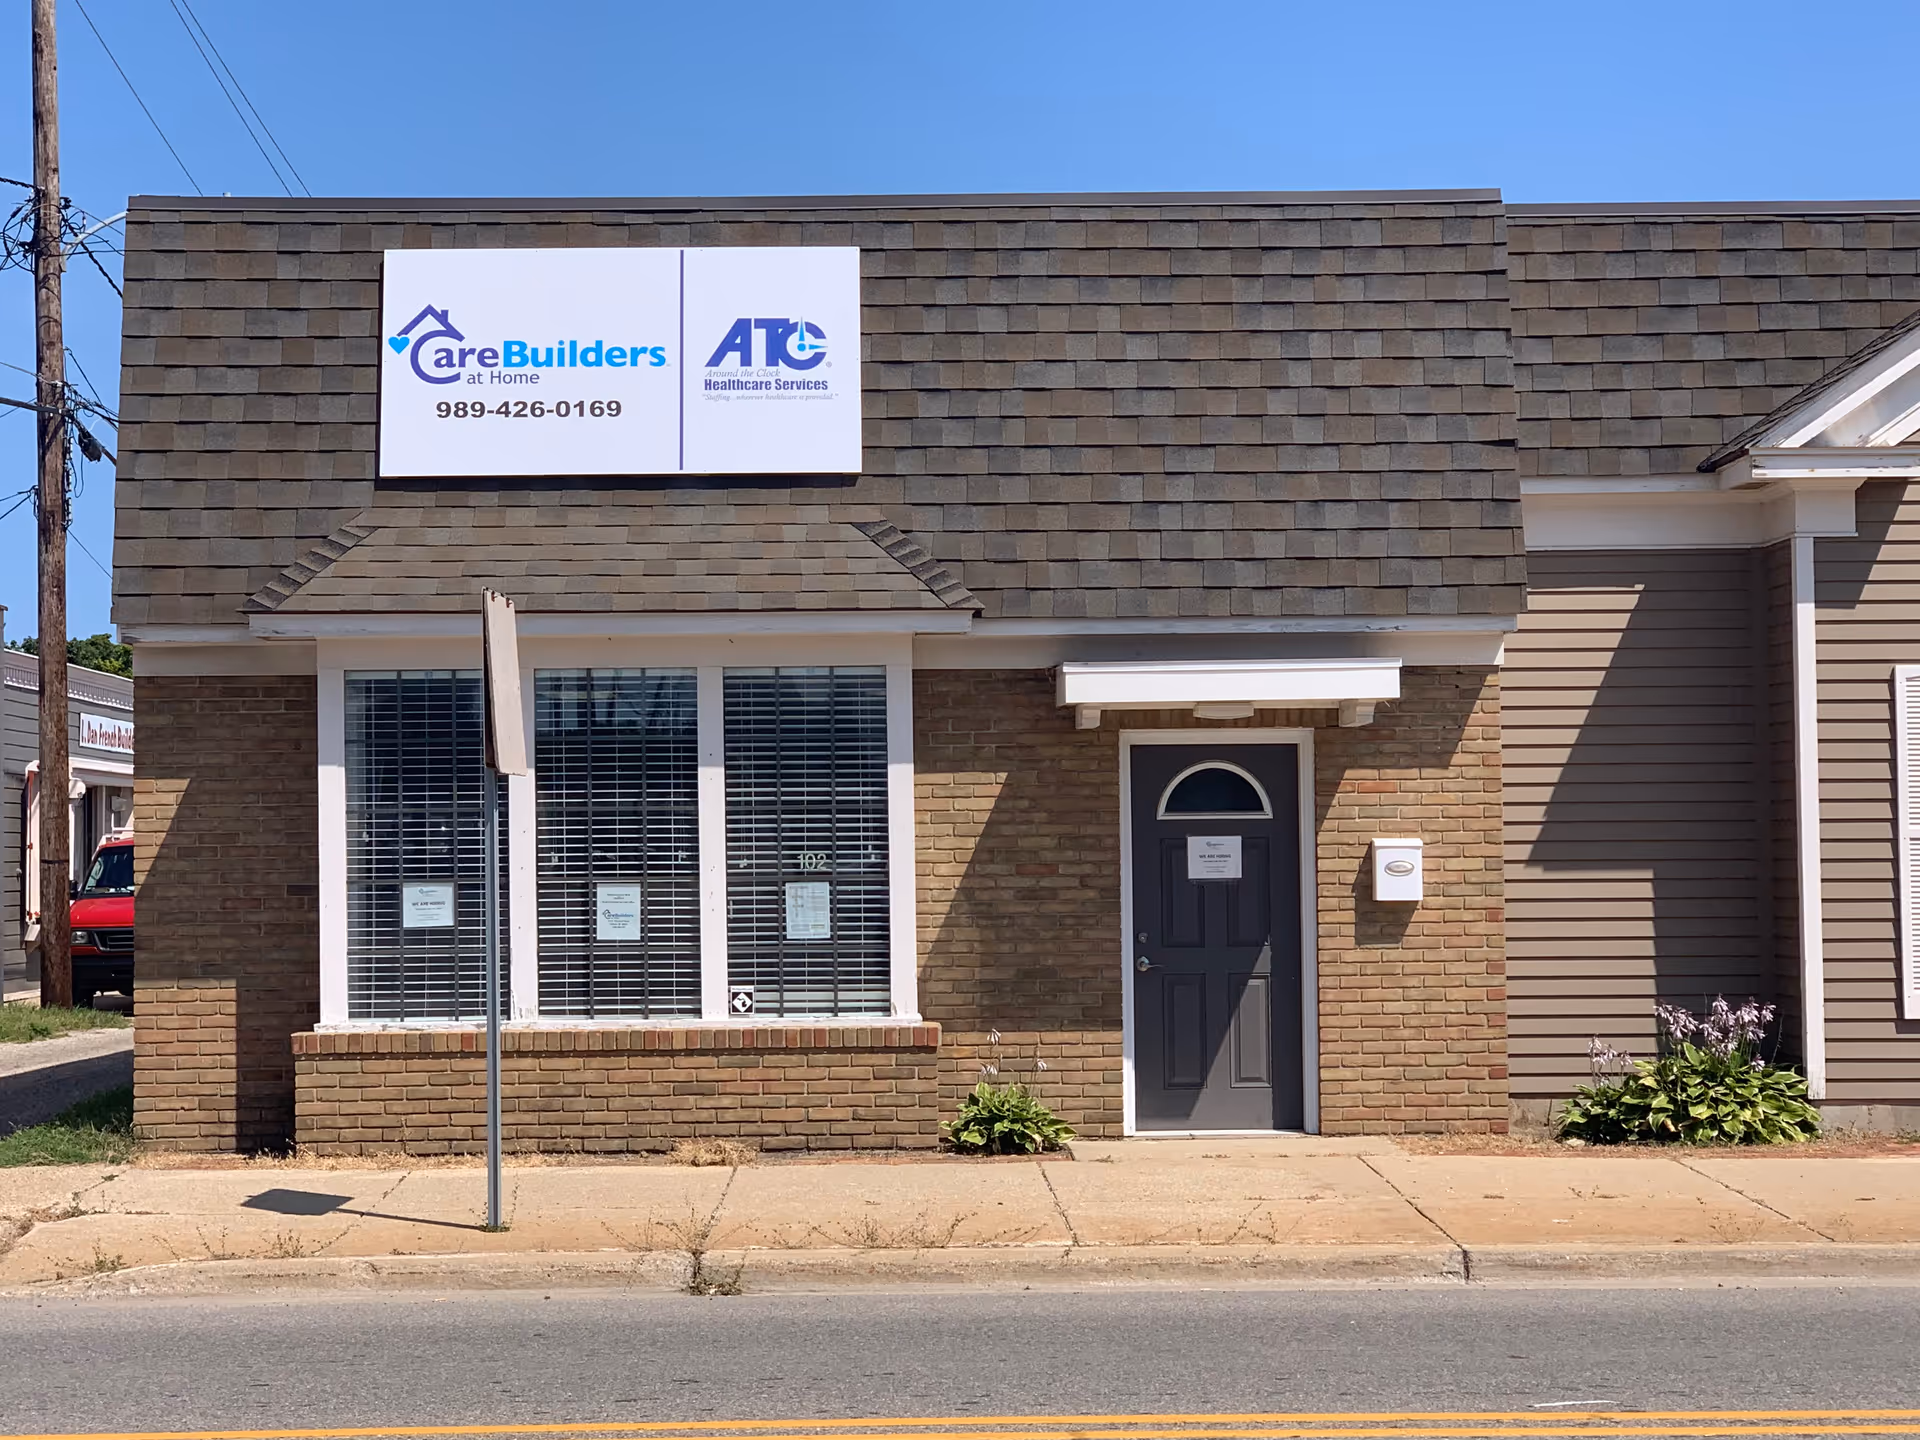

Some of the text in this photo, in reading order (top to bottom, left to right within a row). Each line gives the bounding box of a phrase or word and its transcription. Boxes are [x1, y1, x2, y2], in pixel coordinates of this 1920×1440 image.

[704, 317, 827, 371] ATC
[466, 371, 540, 385] at Home
[704, 368, 781, 378] Around the Clock
[704, 378, 829, 391] Healthcare Services
[435, 399, 622, 419] 989-426-0169
[797, 853, 828, 871] 102
